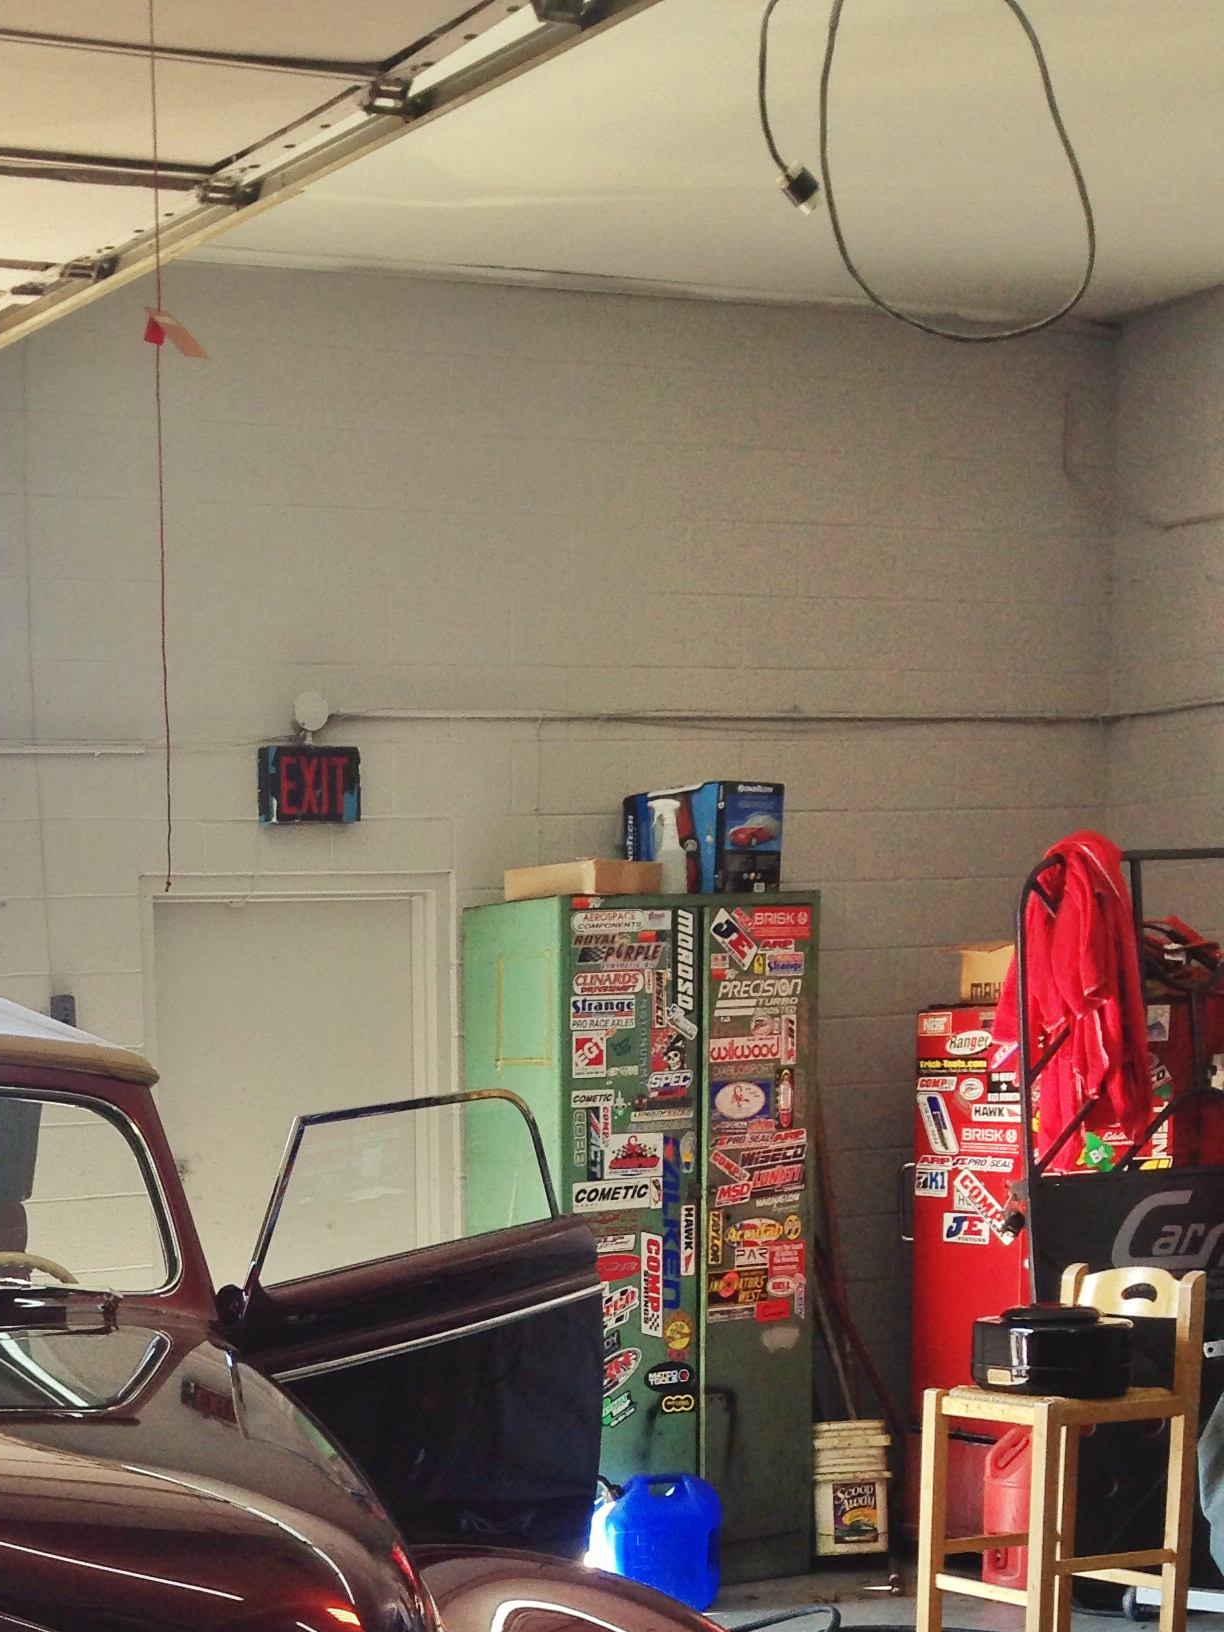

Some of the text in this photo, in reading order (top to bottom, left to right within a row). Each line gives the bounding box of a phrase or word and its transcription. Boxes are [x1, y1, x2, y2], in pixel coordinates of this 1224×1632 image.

[280, 756, 349, 815] EXIT
[583, 911, 636, 921] AEROSPACE
[754, 912, 794, 925] BRISK
[574, 934, 616, 946] ROYAL
[604, 944, 661, 962] PURPLE
[677, 910, 693, 1011] MOROSO
[575, 973, 639, 985] CLINARDS
[655, 971, 666, 1026] WISECO
[970, 981, 1005, 1001] MAH
[572, 998, 634, 1013] Strange
[756, 998, 798, 1006] TURBO
[572, 1019, 588, 1028] PRO
[589, 1019, 610, 1028] RACE
[711, 1037, 780, 1060] wilwood
[949, 1034, 989, 1050] Ranger
[649, 1073, 690, 1088] SPEC
[919, 1079, 947, 1088] COMP
[573, 1093, 612, 1104] COMETIC
[974, 1107, 1005, 1117] HAWK
[962, 1128, 1004, 1142] BRISK
[991, 1160, 1012, 1168] SEAL
[575, 1182, 649, 1203] COMETIC
[718, 1184, 750, 1197] MSD
[959, 1174, 1004, 1223] COMP
[683, 1207, 694, 1251] HAWK
[946, 1216, 984, 1238] JE
[647, 1239, 661, 1313] COMP
[835, 1484, 874, 1504] Scoop
[838, 1494, 875, 1515] Away
